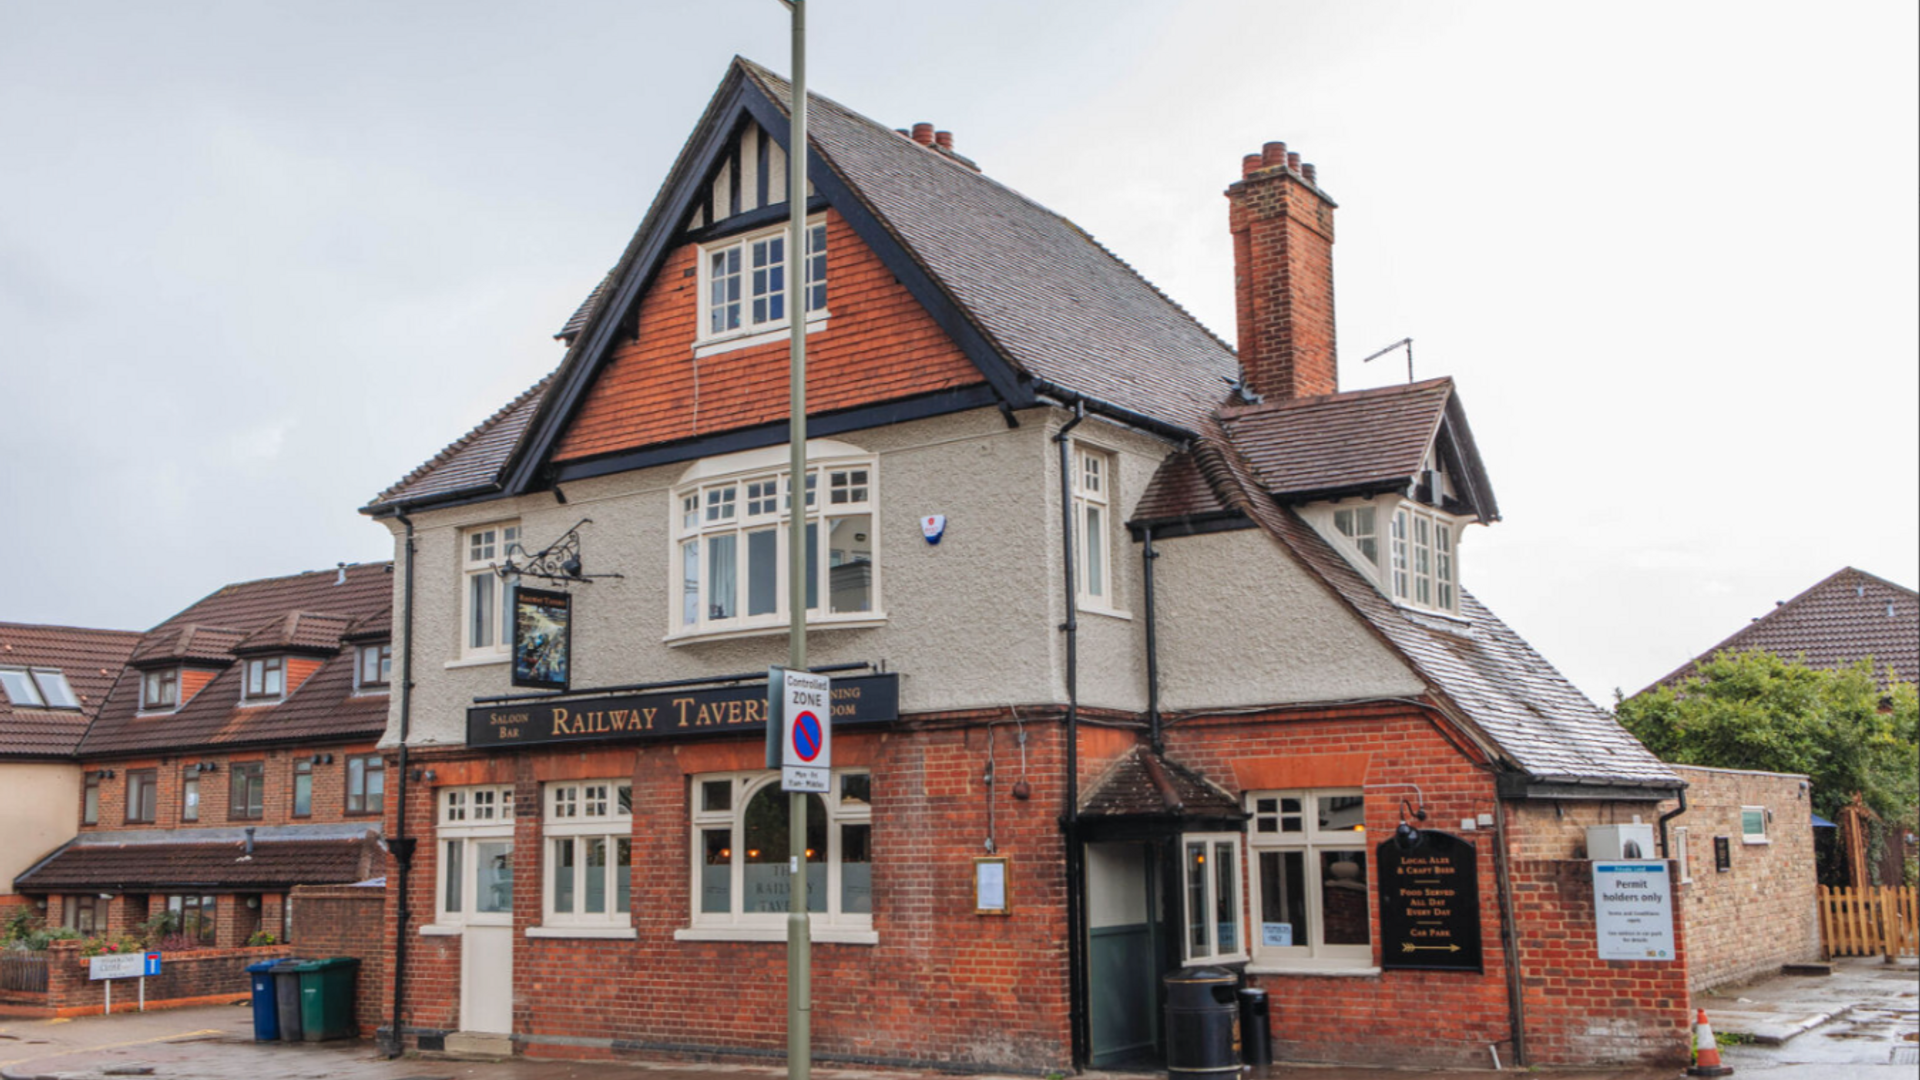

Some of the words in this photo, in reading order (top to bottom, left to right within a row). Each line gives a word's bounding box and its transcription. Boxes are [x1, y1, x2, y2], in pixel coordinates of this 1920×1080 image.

[787, 676, 827, 691] Controlled
[792, 691, 822, 707] ZONE
[490, 713, 529, 725] SALOON
[551, 708, 658, 736] RAILWAY
[499, 726, 519, 739] BAR
[1401, 857, 1427, 865] LOCAL
[1406, 866, 1432, 874] CRAFT
[1616, 880, 1648, 889] Permit
[1400, 888, 1422, 896] FOOD
[1425, 888, 1455, 896] SERVED
[1410, 898, 1426, 906] ALL
[1429, 898, 1445, 906] DAY
[1603, 893, 1639, 902] holders
[1641, 893, 1662, 904] only
[1406, 908, 1431, 916] EVERY
[1434, 908, 1451, 916] DAY
[1410, 928, 1427, 937] CAR
[1429, 929, 1451, 937] PARK
